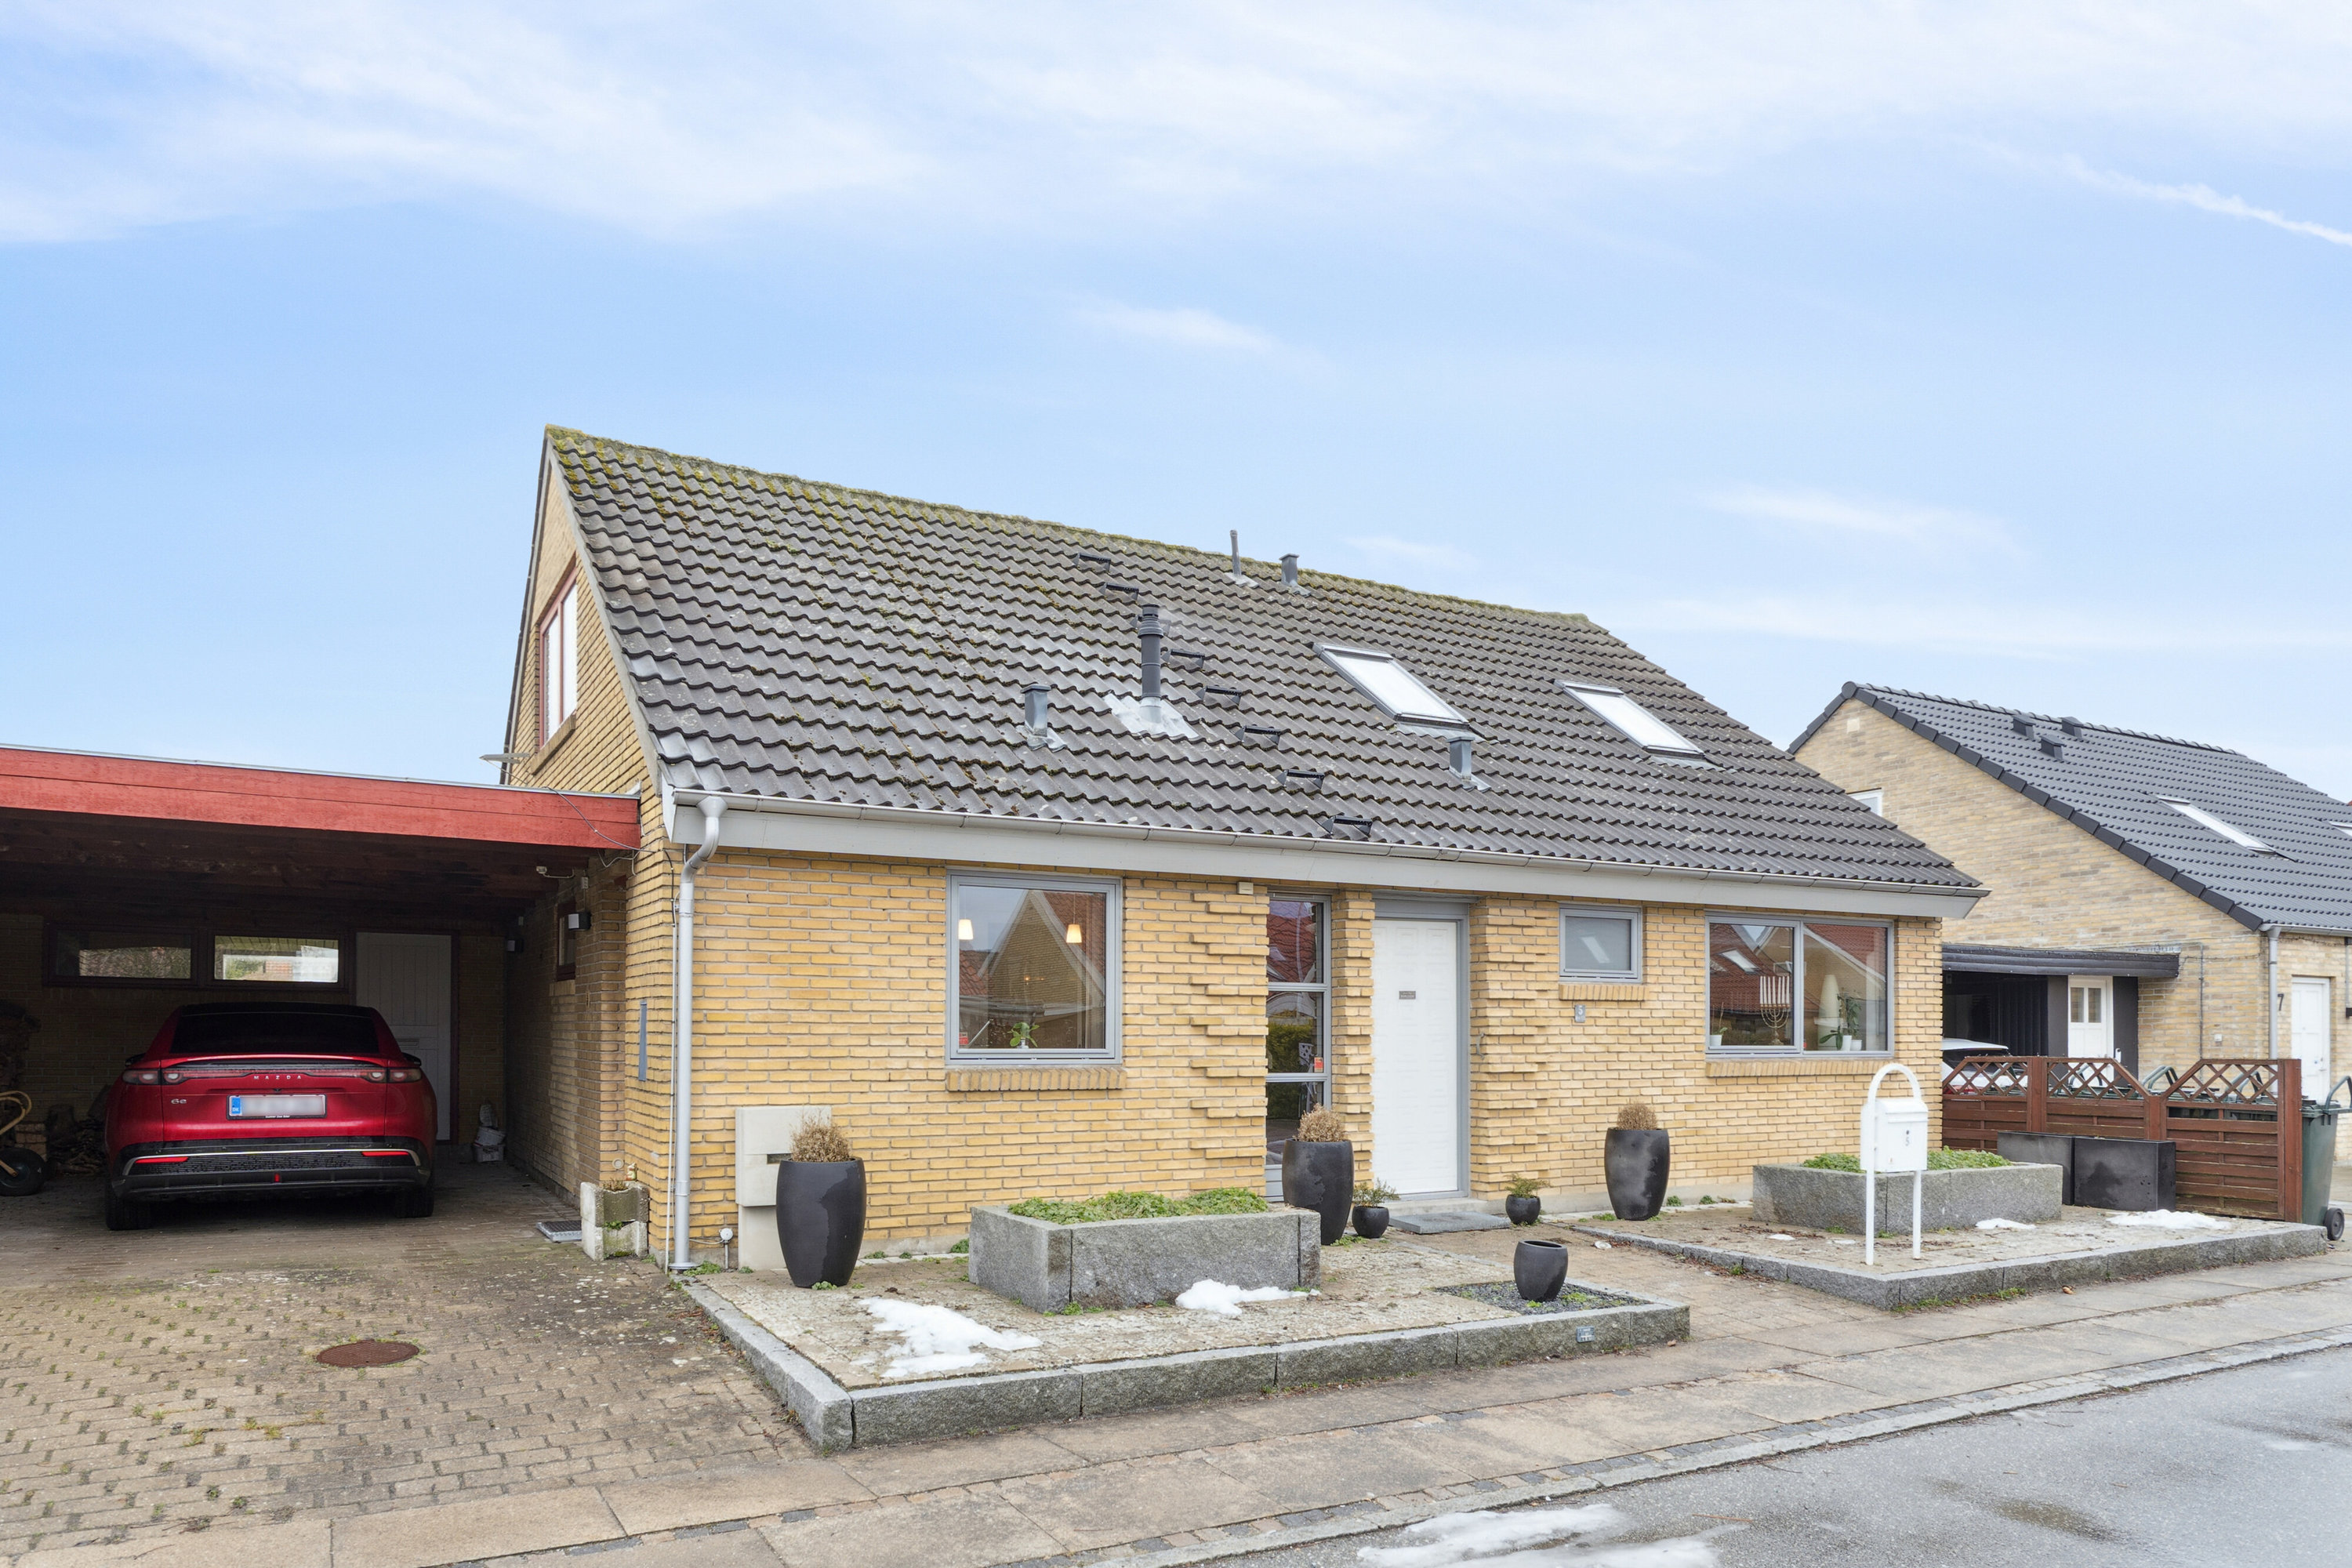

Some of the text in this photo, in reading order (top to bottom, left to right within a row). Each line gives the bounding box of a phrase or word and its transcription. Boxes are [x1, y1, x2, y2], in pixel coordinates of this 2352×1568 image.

[2277, 993, 2285, 1011] 7
[1578, 1004, 1584, 1015] 5
[1905, 1137, 1910, 1146] 5
